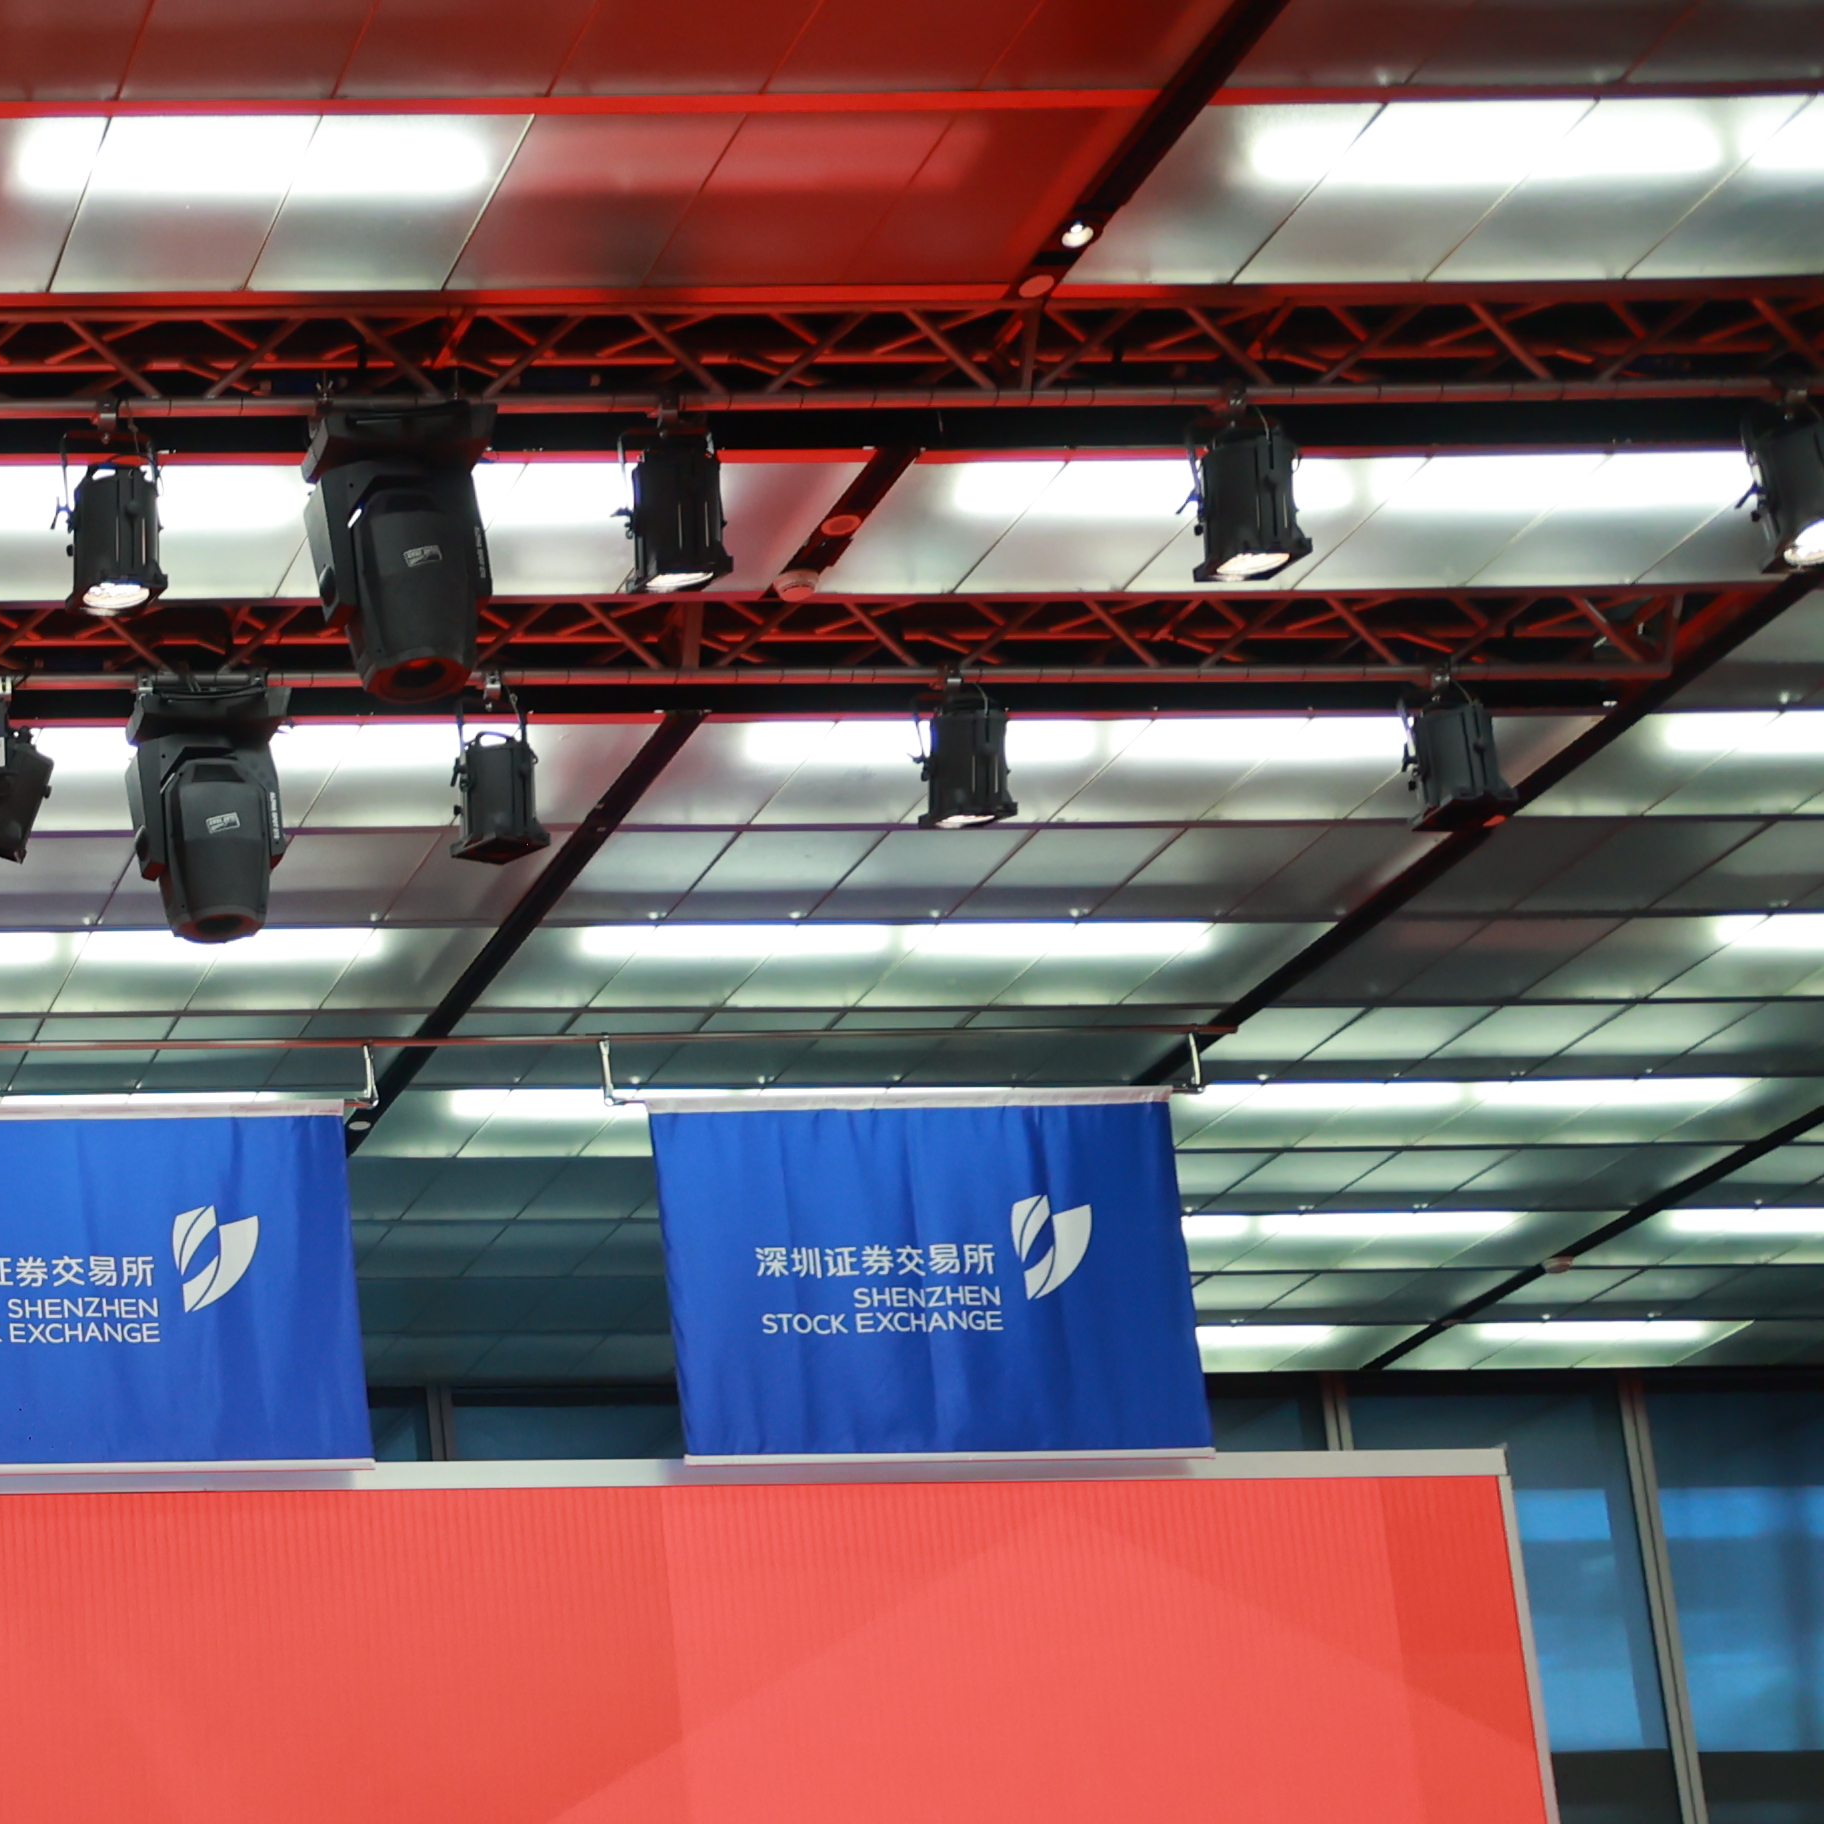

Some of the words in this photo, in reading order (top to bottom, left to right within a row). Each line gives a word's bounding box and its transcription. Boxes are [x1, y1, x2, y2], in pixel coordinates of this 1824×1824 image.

[755, 1243, 996, 1279] 深圳证券交易所
[7, 1297, 159, 1319] SHENZHEN
[853, 1285, 1001, 1308] SHENZHEN
[9, 1321, 161, 1344] EXCHANGE
[762, 1313, 849, 1335] STOCK
[855, 1310, 1004, 1333] EXCHANGE
